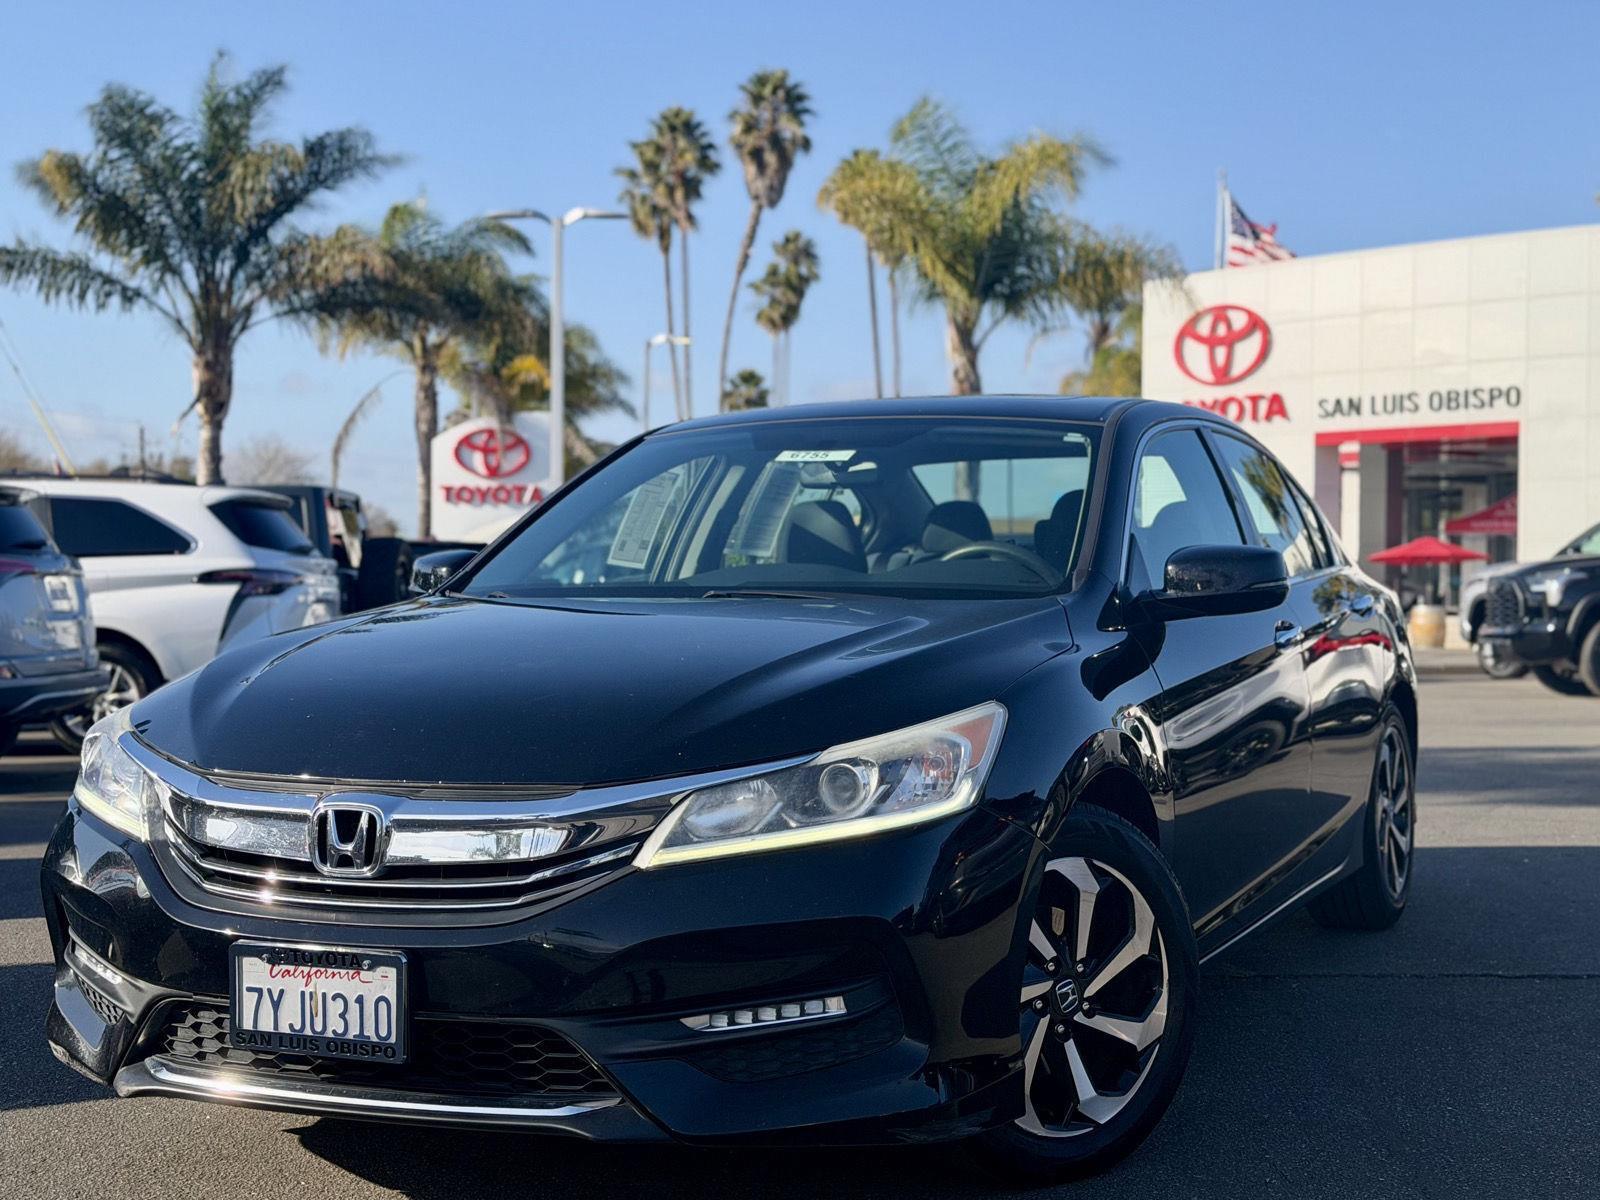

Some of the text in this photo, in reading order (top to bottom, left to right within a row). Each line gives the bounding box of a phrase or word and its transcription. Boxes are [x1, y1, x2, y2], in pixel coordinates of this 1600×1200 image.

[1183, 393, 1290, 423] YOTA
[1318, 386, 1522, 418] SAN LUIS OBISPO
[442, 485, 544, 504] TOYOTA
[293, 951, 362, 968] TOYOTA
[269, 964, 373, 988] California
[246, 986, 393, 1042] 7YJU310
[235, 1031, 397, 1059] SAN LUIS OBISPO
